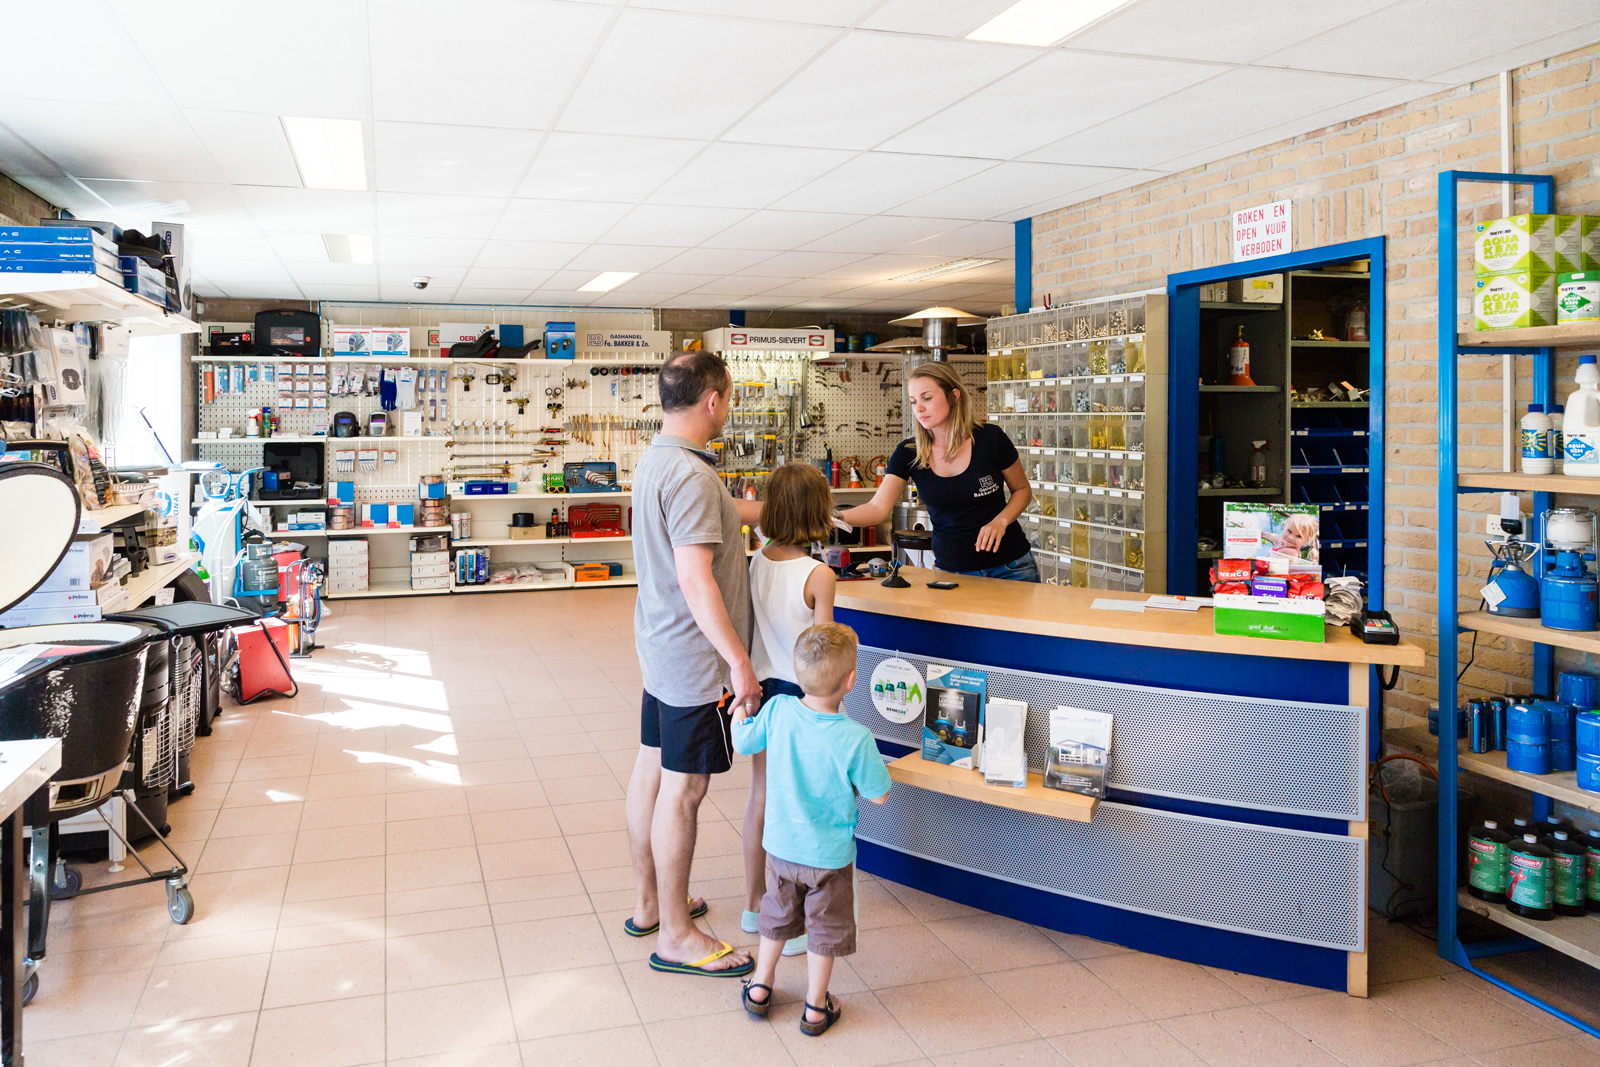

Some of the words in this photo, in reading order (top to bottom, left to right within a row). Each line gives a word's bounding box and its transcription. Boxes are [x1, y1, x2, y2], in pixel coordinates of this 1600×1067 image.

[1237, 208, 1264, 225] ROKEN
[1273, 204, 1285, 218] EN
[1236, 226, 1257, 242] OPEN
[1265, 220, 1287, 236] VUUR
[1482, 234, 1520, 247] AQUA
[1240, 238, 1282, 257] VERBODEN
[1483, 243, 1519, 255] KEM
[1483, 251, 1519, 260] NATURAL
[1481, 291, 1520, 303] AQUA
[1483, 300, 1519, 311] KEM
[1483, 308, 1519, 316] NATURAL
[749, 336, 807, 344] PRIMUS-SIEVERT
[1513, 855, 1536, 866] Coleman
